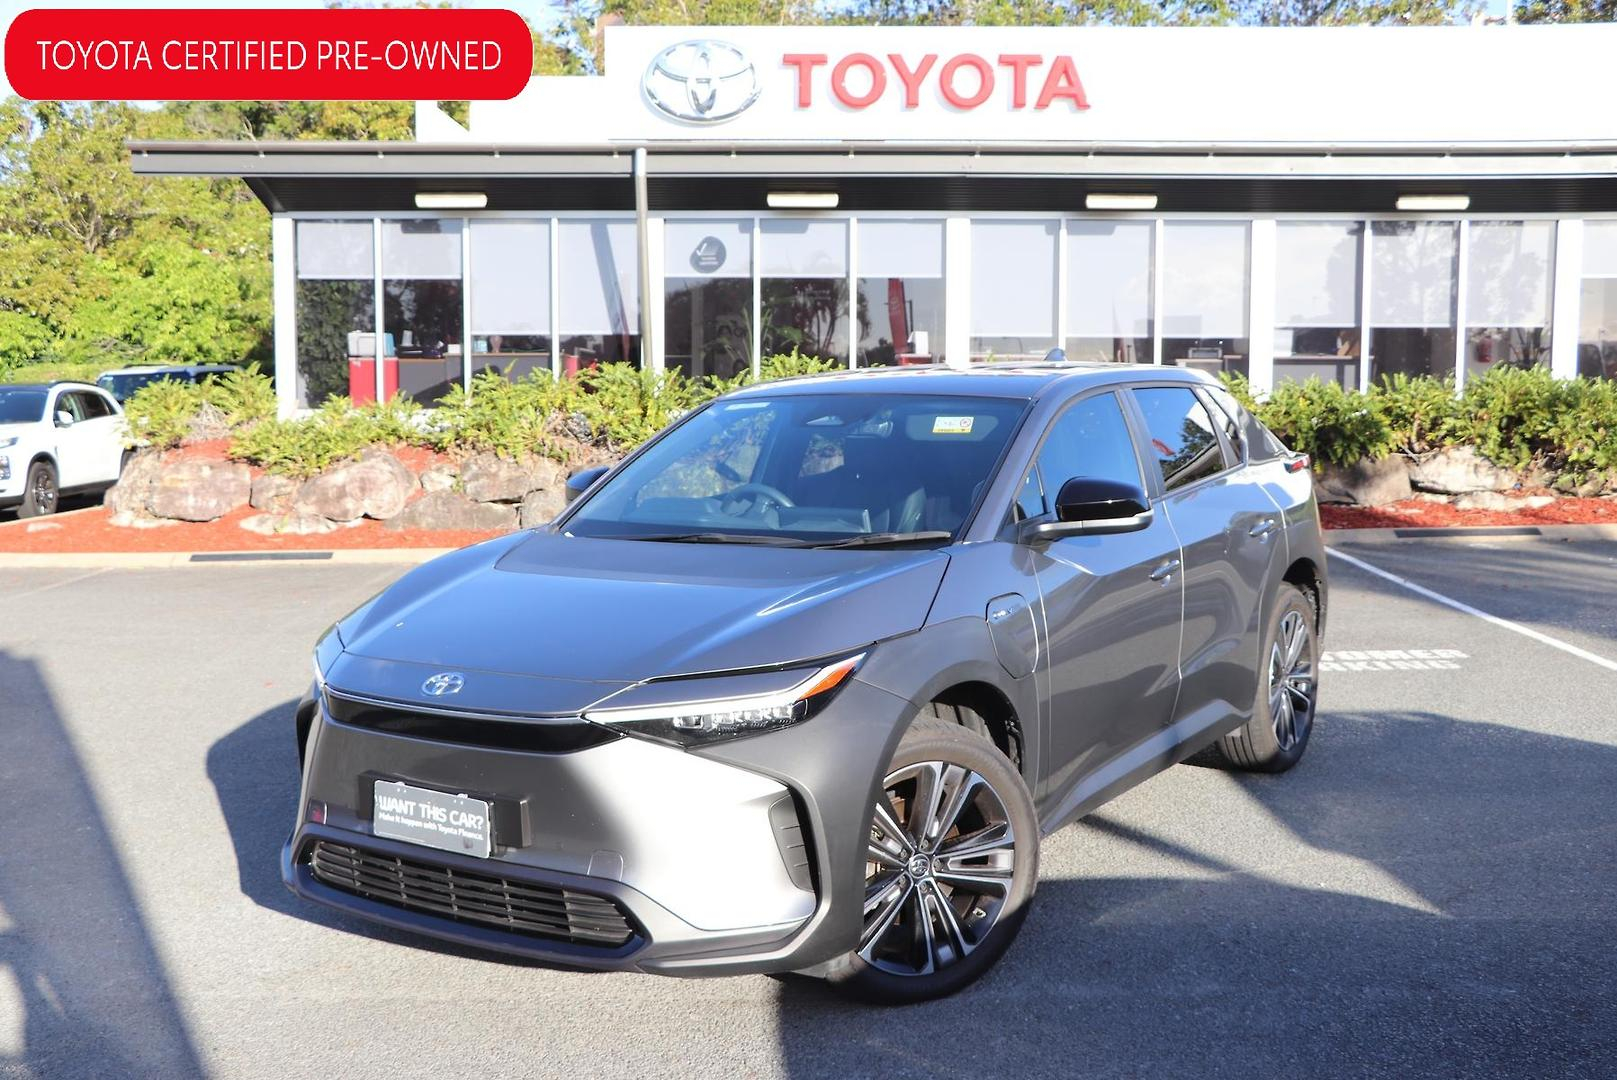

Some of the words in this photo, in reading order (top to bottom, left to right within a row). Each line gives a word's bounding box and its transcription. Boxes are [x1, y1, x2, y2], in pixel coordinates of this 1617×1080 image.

[782, 53, 1091, 111] TOYOTA
[378, 795, 417, 816] WANT
[418, 802, 448, 823] THIS
[449, 810, 484, 831] CAR?
